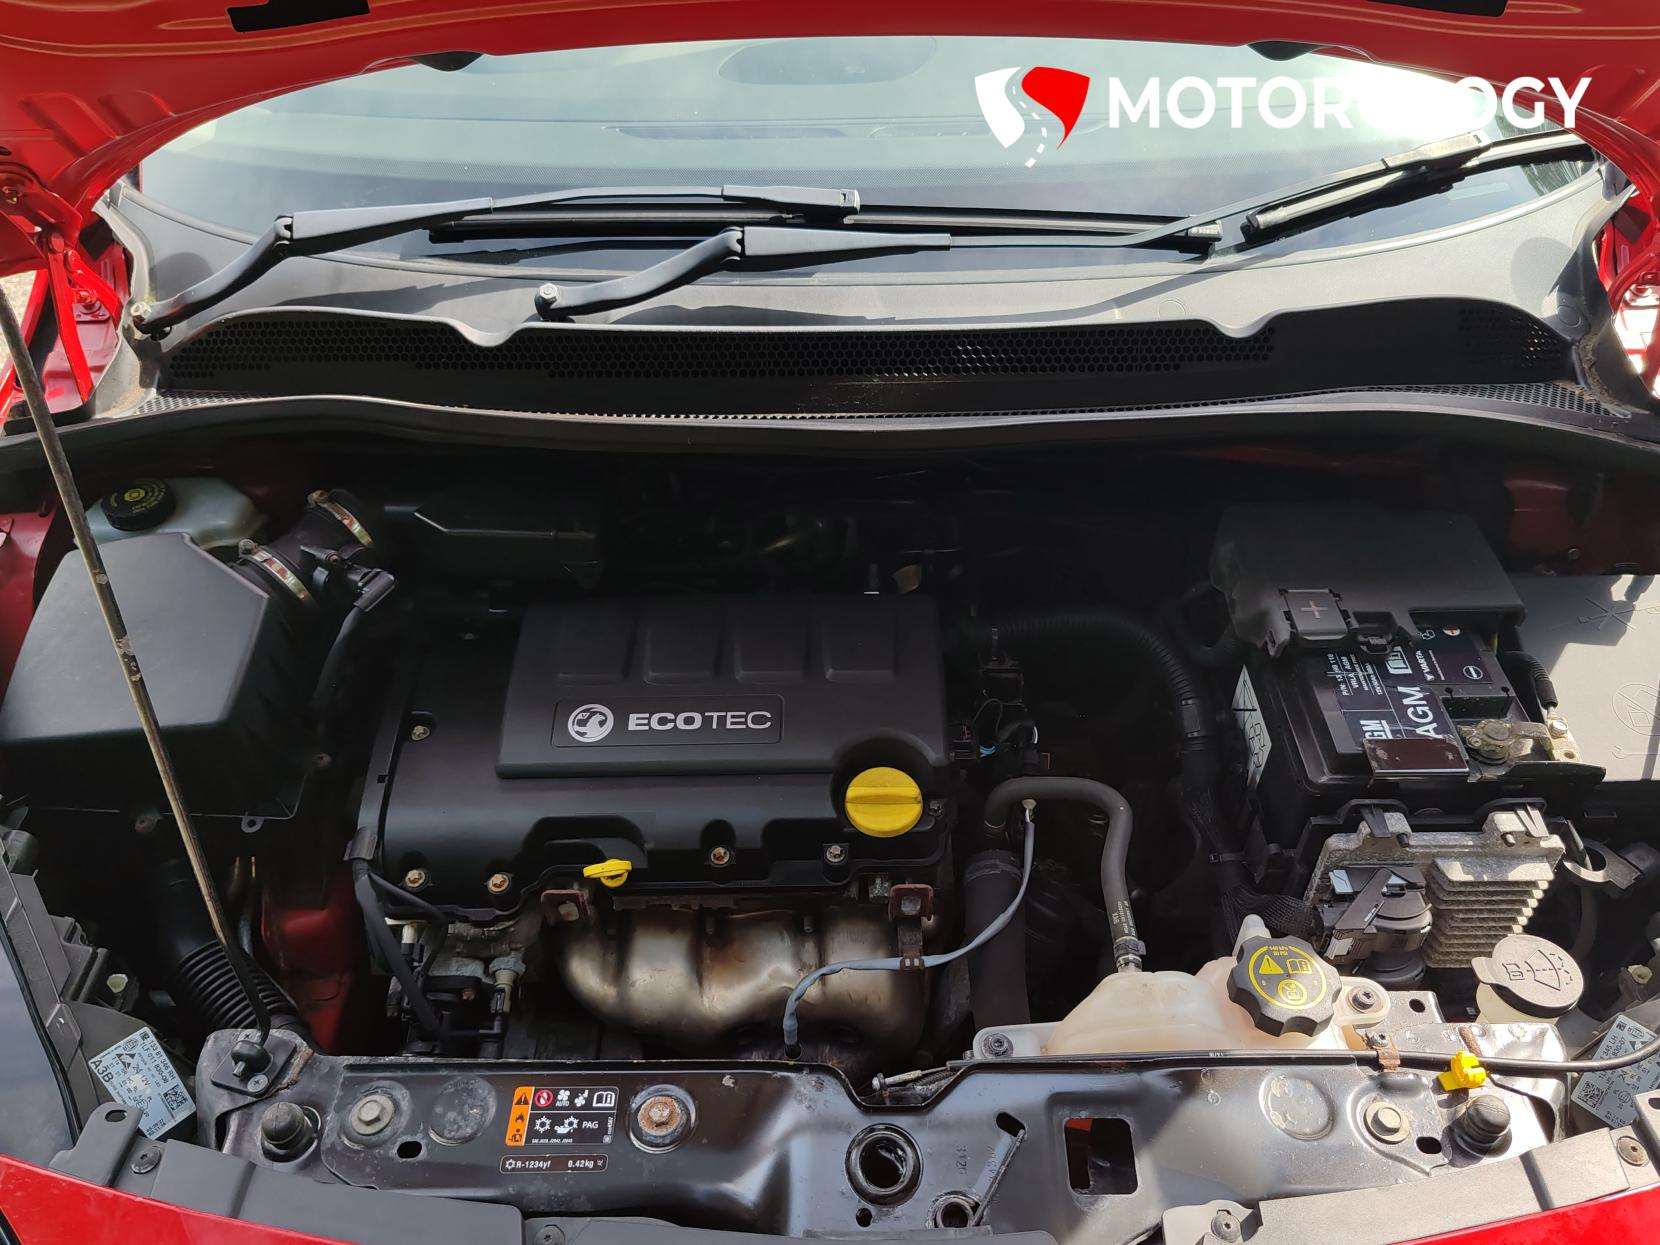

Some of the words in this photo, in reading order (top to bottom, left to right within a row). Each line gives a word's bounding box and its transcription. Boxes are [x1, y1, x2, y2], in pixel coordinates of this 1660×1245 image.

[628, 711, 772, 731] ECOTEC
[1397, 686, 1443, 739] AGM
[1360, 720, 1388, 739] GM
[91, 1057, 114, 1084] A3B
[582, 1121, 599, 1129] PAG
[515, 1160, 551, 1169] R-1234yf
